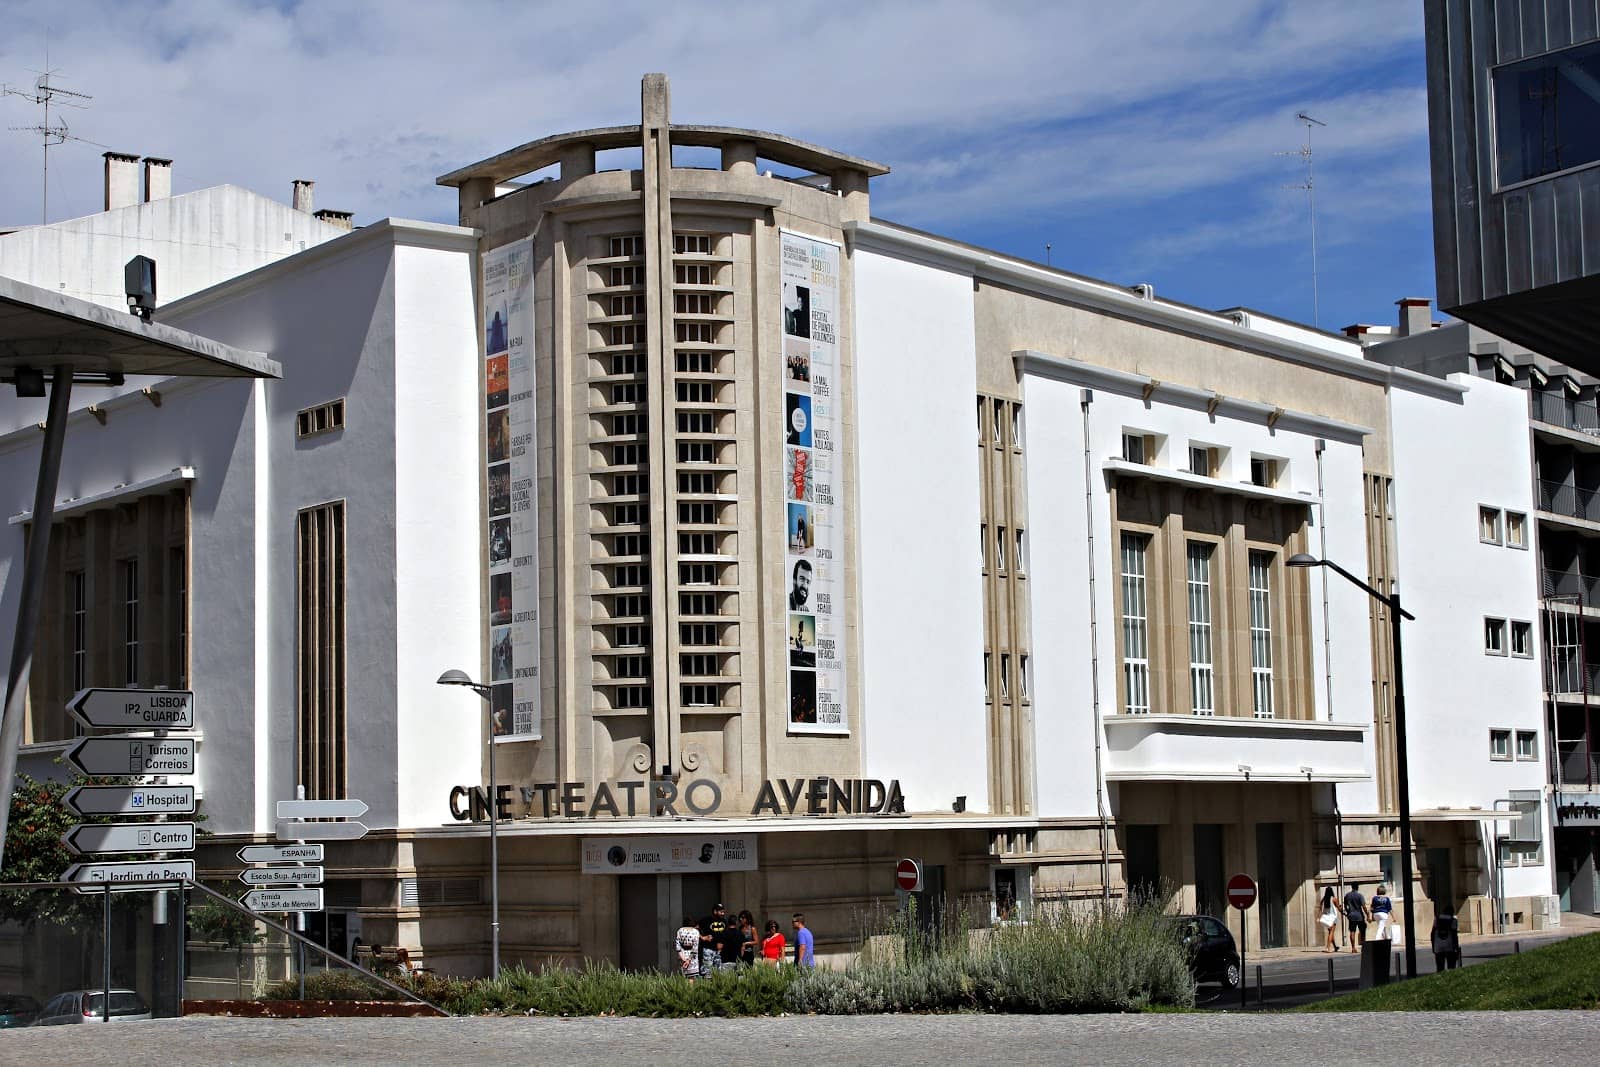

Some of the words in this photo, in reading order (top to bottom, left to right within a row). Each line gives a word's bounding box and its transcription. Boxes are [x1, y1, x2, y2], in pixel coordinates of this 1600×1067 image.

[150, 697, 187, 708] LISBOA
[125, 703, 140, 715] IP2
[143, 711, 187, 722] GUARDA
[148, 744, 188, 756] Turismo
[145, 758, 188, 769] Correios
[146, 793, 188, 806] Hospital
[533, 778, 722, 818] TEATRO
[750, 777, 906, 815] AVENIDA
[153, 831, 188, 844] Centro
[723, 839, 745, 850] MIGUEL
[281, 849, 317, 857] ESPANHA
[251, 872, 272, 880] Escola
[274, 872, 290, 881] Sup.
